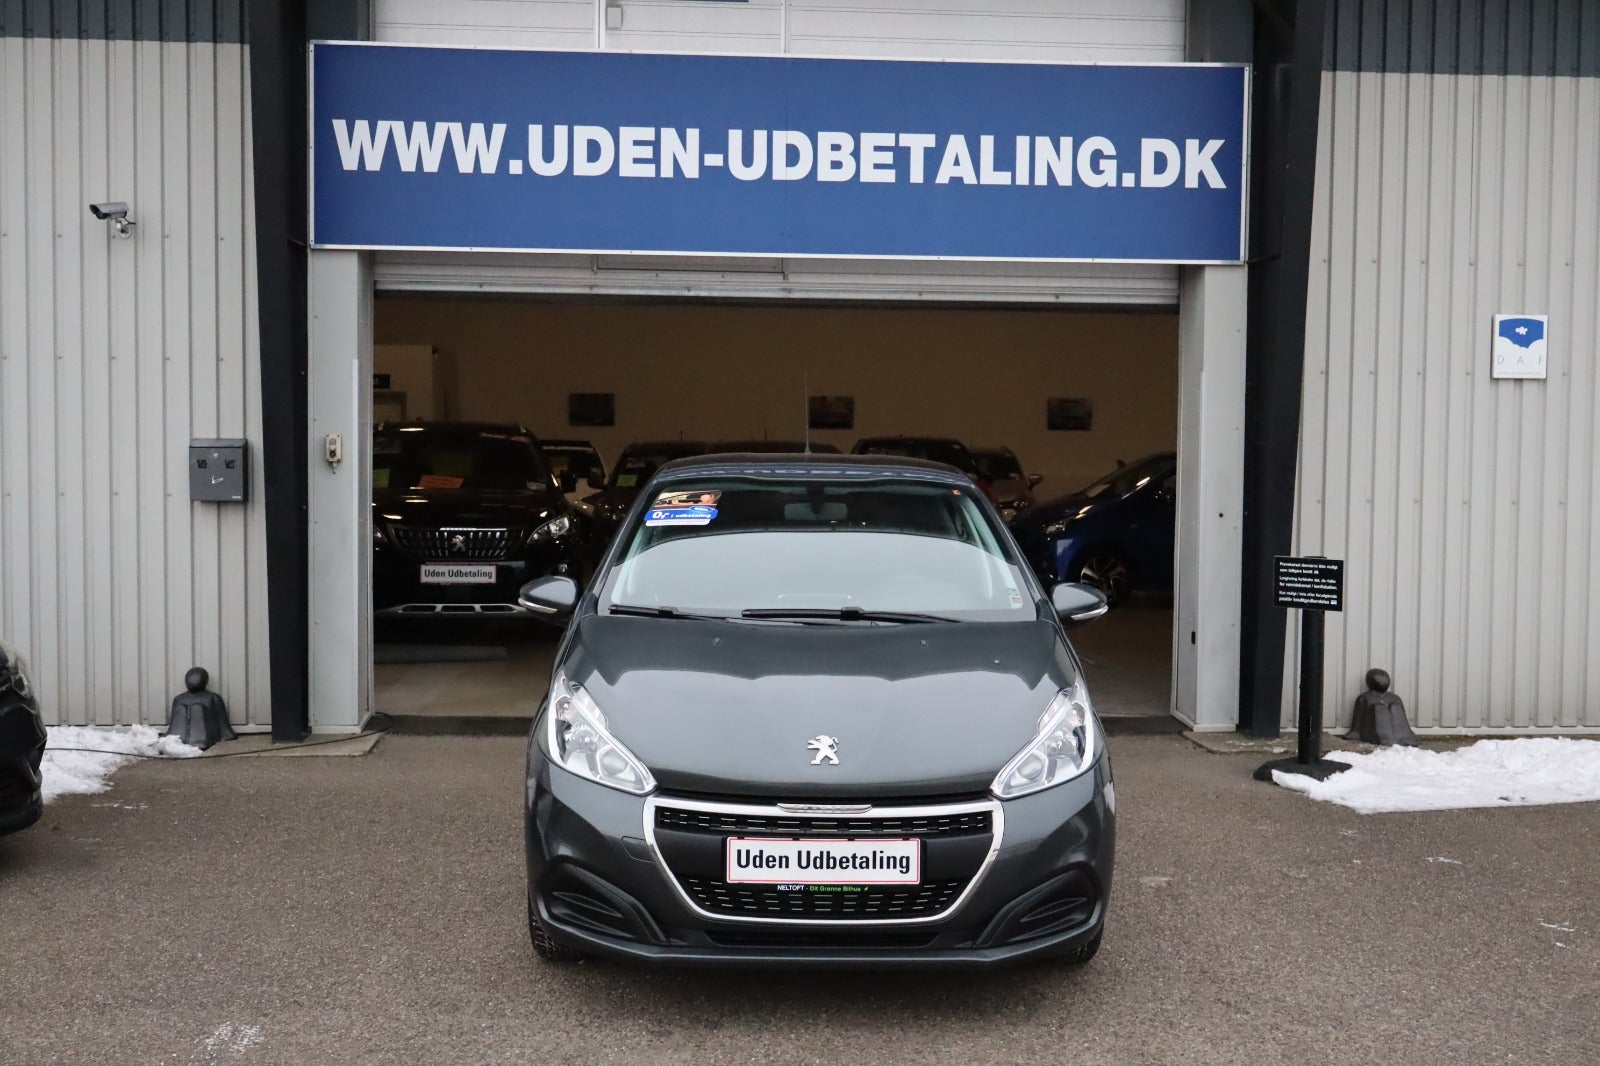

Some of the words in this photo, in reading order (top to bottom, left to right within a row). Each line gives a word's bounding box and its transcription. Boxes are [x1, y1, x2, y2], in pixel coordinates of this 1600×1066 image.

[332, 119, 1227, 190] WWW.UDEN-UDBETALING.DK
[424, 569, 446, 578] Uden
[448, 569, 493, 579] Udbetaling
[736, 849, 790, 869] Uden
[797, 849, 910, 875] Udbetaling
